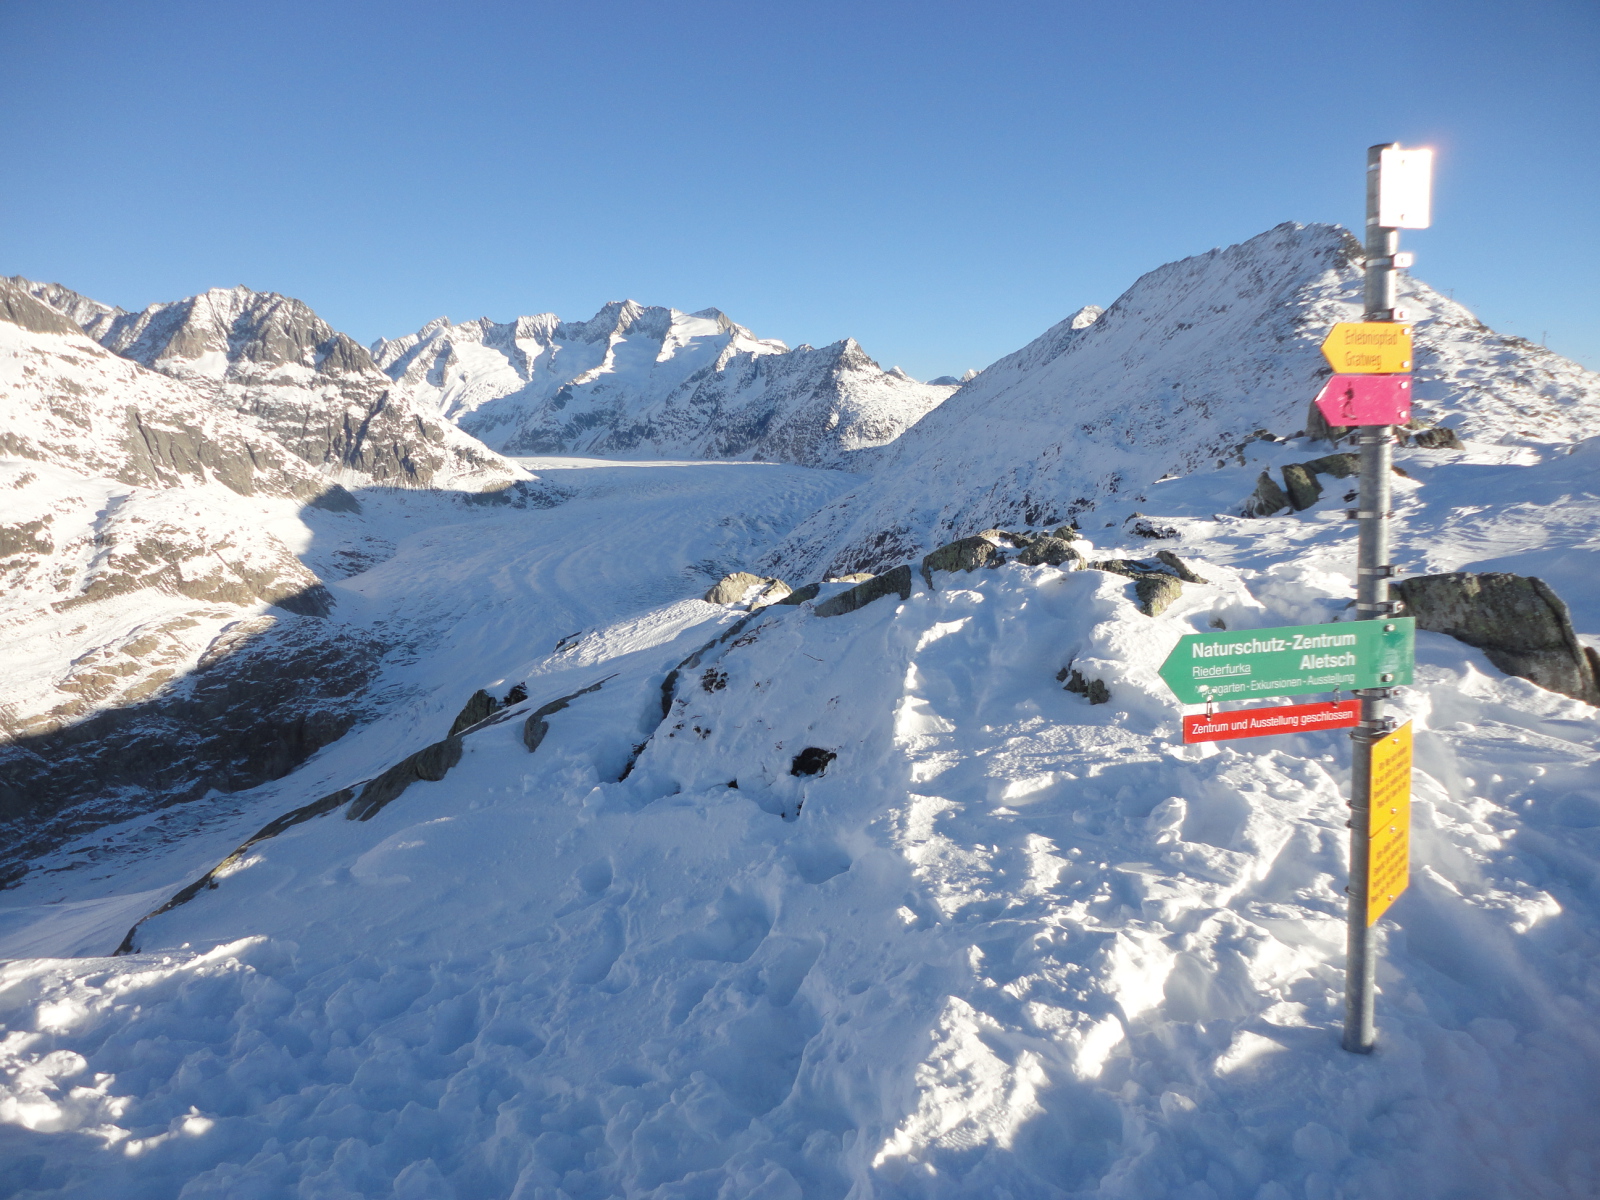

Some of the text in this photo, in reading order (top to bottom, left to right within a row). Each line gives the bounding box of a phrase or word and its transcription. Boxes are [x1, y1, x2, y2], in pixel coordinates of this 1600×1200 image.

[1345, 351, 1382, 370] Gratweg
[1192, 633, 1356, 659] Naturschutz-Zentrum
[1192, 663, 1251, 678] Riederfurka
[1299, 652, 1356, 671] Aletsch
[1250, 677, 1302, 691] Exkursionen
[1192, 709, 1353, 735] Zentrum und Ausstellung geschlossen
